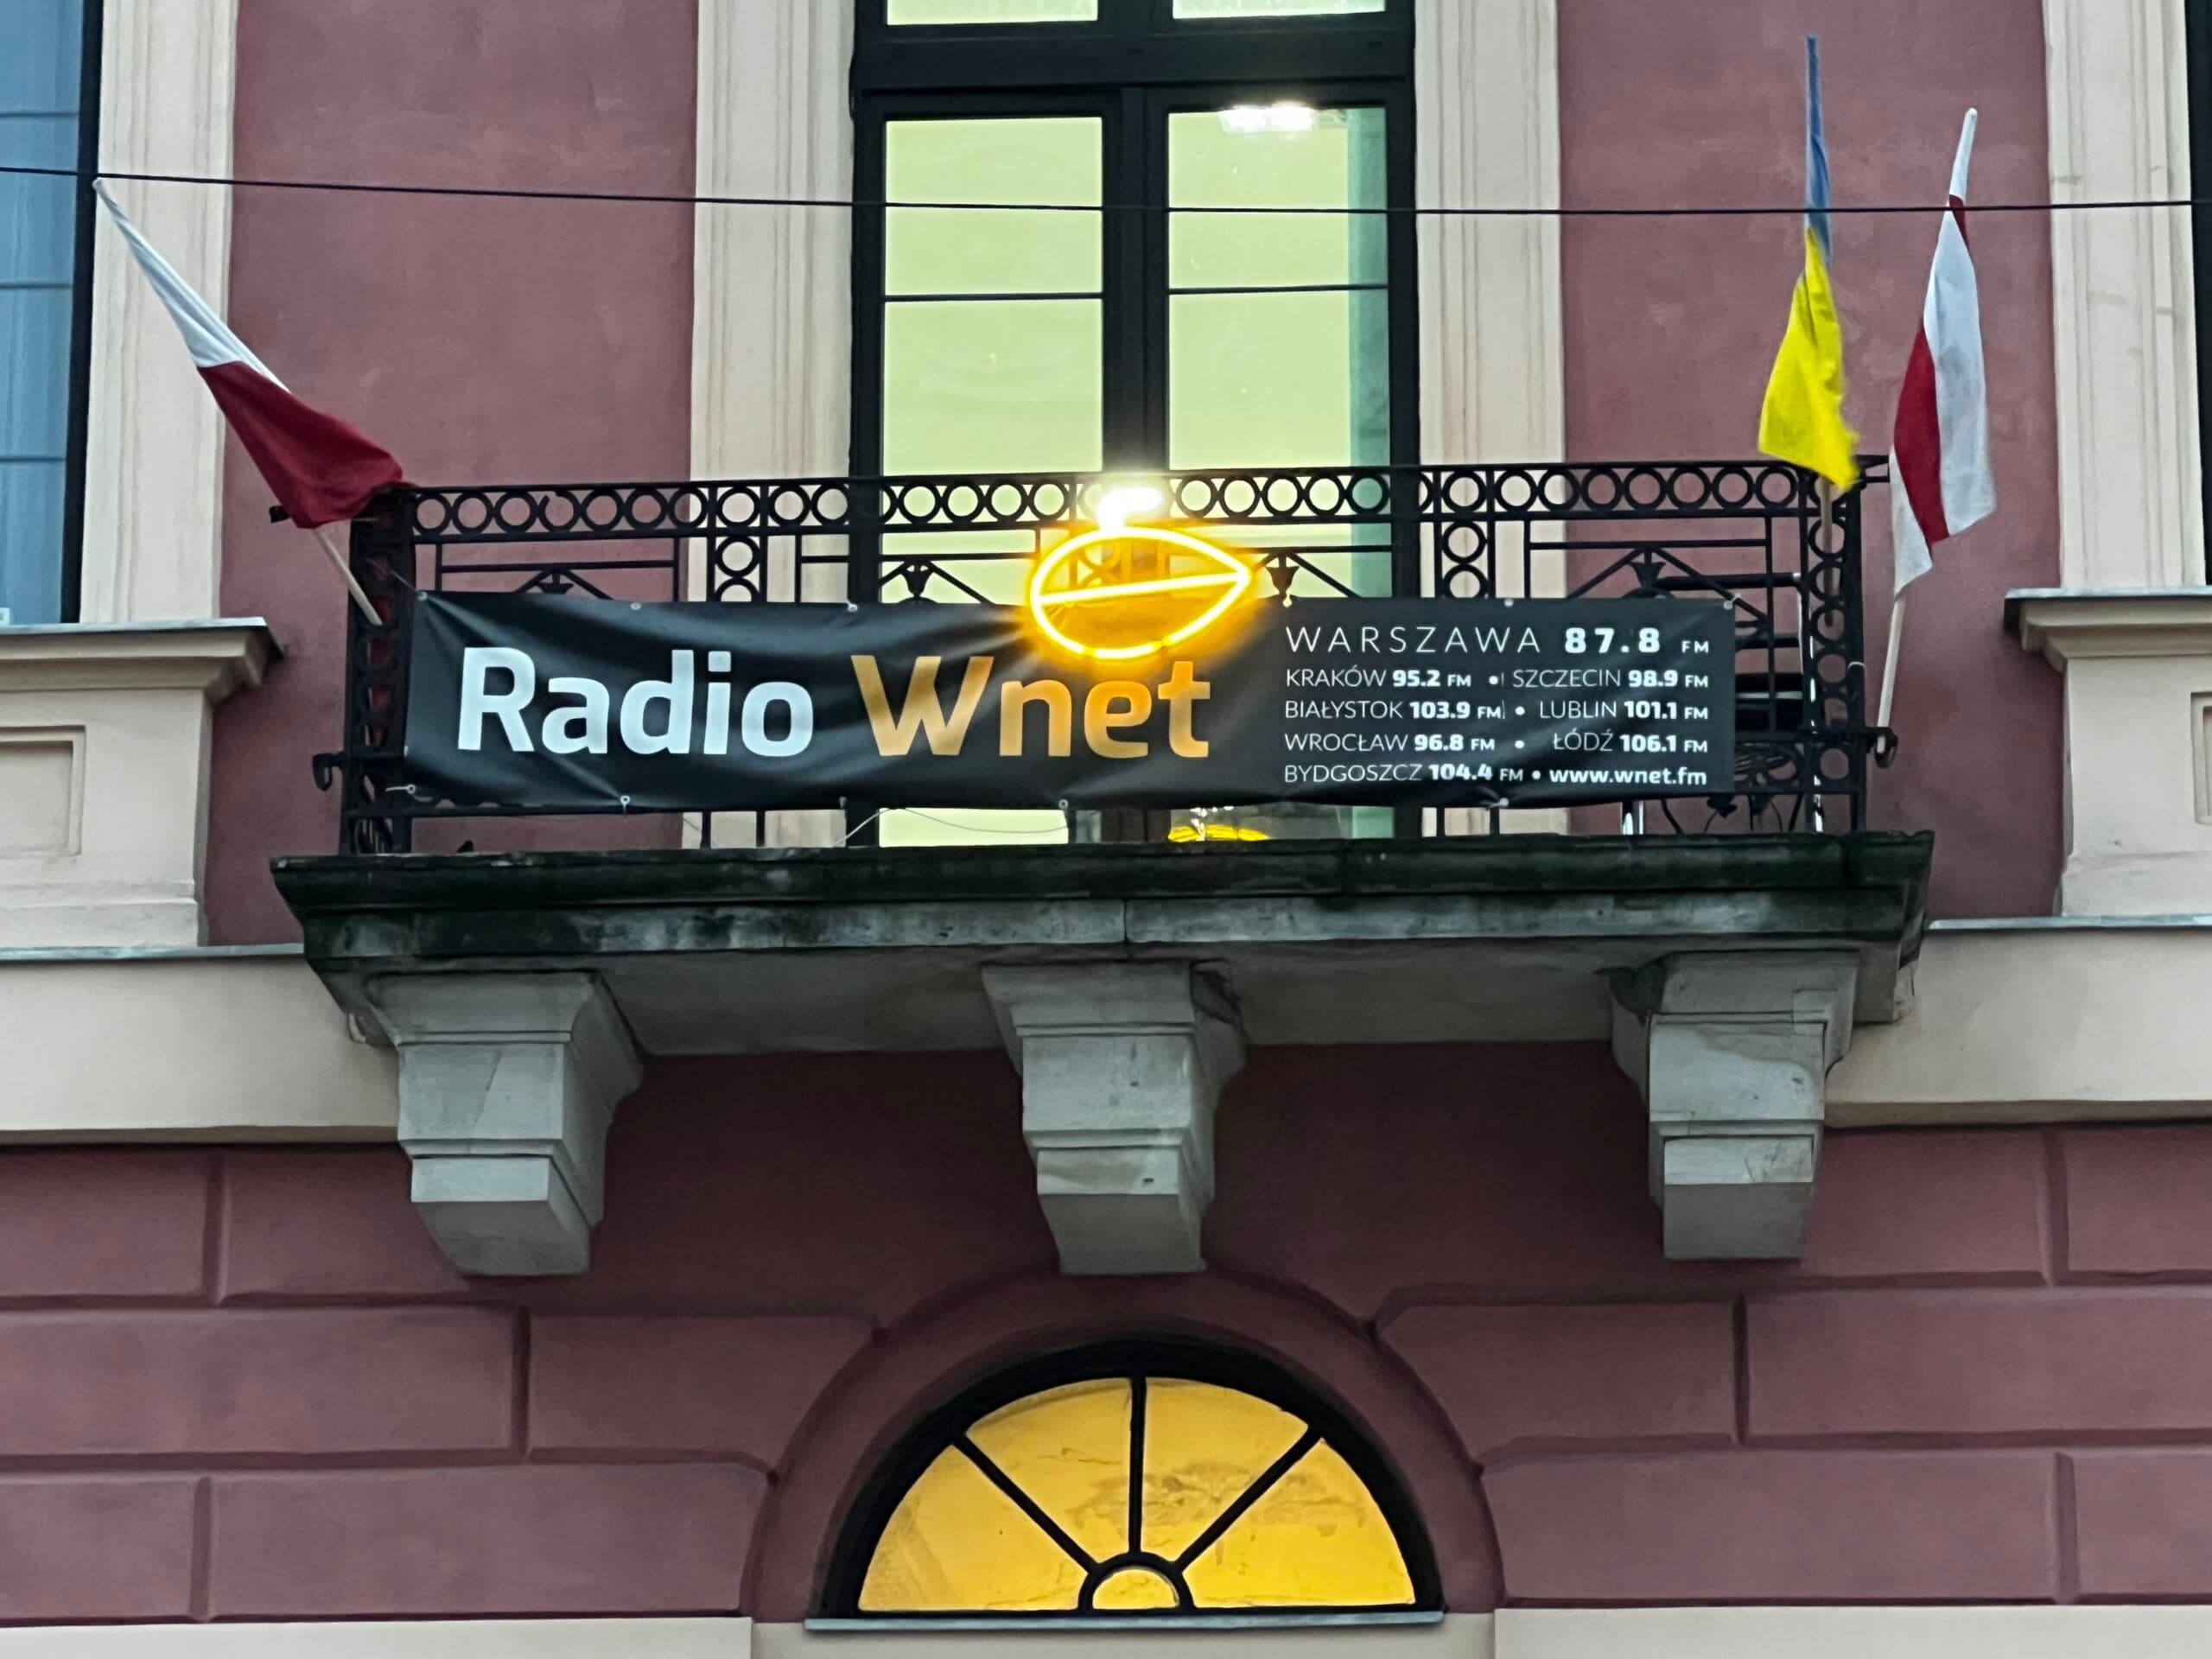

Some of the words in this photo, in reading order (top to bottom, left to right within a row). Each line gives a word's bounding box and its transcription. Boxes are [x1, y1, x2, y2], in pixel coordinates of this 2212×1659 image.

[1286, 626, 1540, 652] WARSZAWA
[1565, 627, 1660, 653] 87.8
[1681, 640, 1709, 653] FM
[1286, 664, 1387, 687] KRAKÓW
[1392, 669, 1441, 687] 95.2
[1447, 674, 1471, 687] FM
[1512, 669, 1621, 688] SZCZECIN
[1628, 670, 1679, 688] 98.9
[1685, 675, 1708, 688] FM
[457, 646, 815, 757] Radio
[851, 654, 1211, 758] Wnet
[1285, 700, 1403, 719] BIAŁYSTOK
[1409, 701, 1471, 719] 103.9
[1478, 707, 1501, 719] FM
[1540, 701, 1617, 719] LUBLIN
[1624, 701, 1677, 719] 101.1
[1684, 707, 1708, 720] FM
[1284, 733, 1408, 752] WROCŁAW
[1414, 734, 1464, 751] 96.8
[1471, 738, 1495, 751] FM
[1553, 728, 1613, 752] ŁÓDŹ
[1619, 734, 1676, 753] 106.1
[1684, 740, 1708, 753] FM
[1285, 764, 1422, 782] BYDGOSZCZ
[1428, 764, 1493, 781] 104.4
[1499, 768, 1523, 781] FM
[1549, 766, 1707, 785] www.wnet.fm
